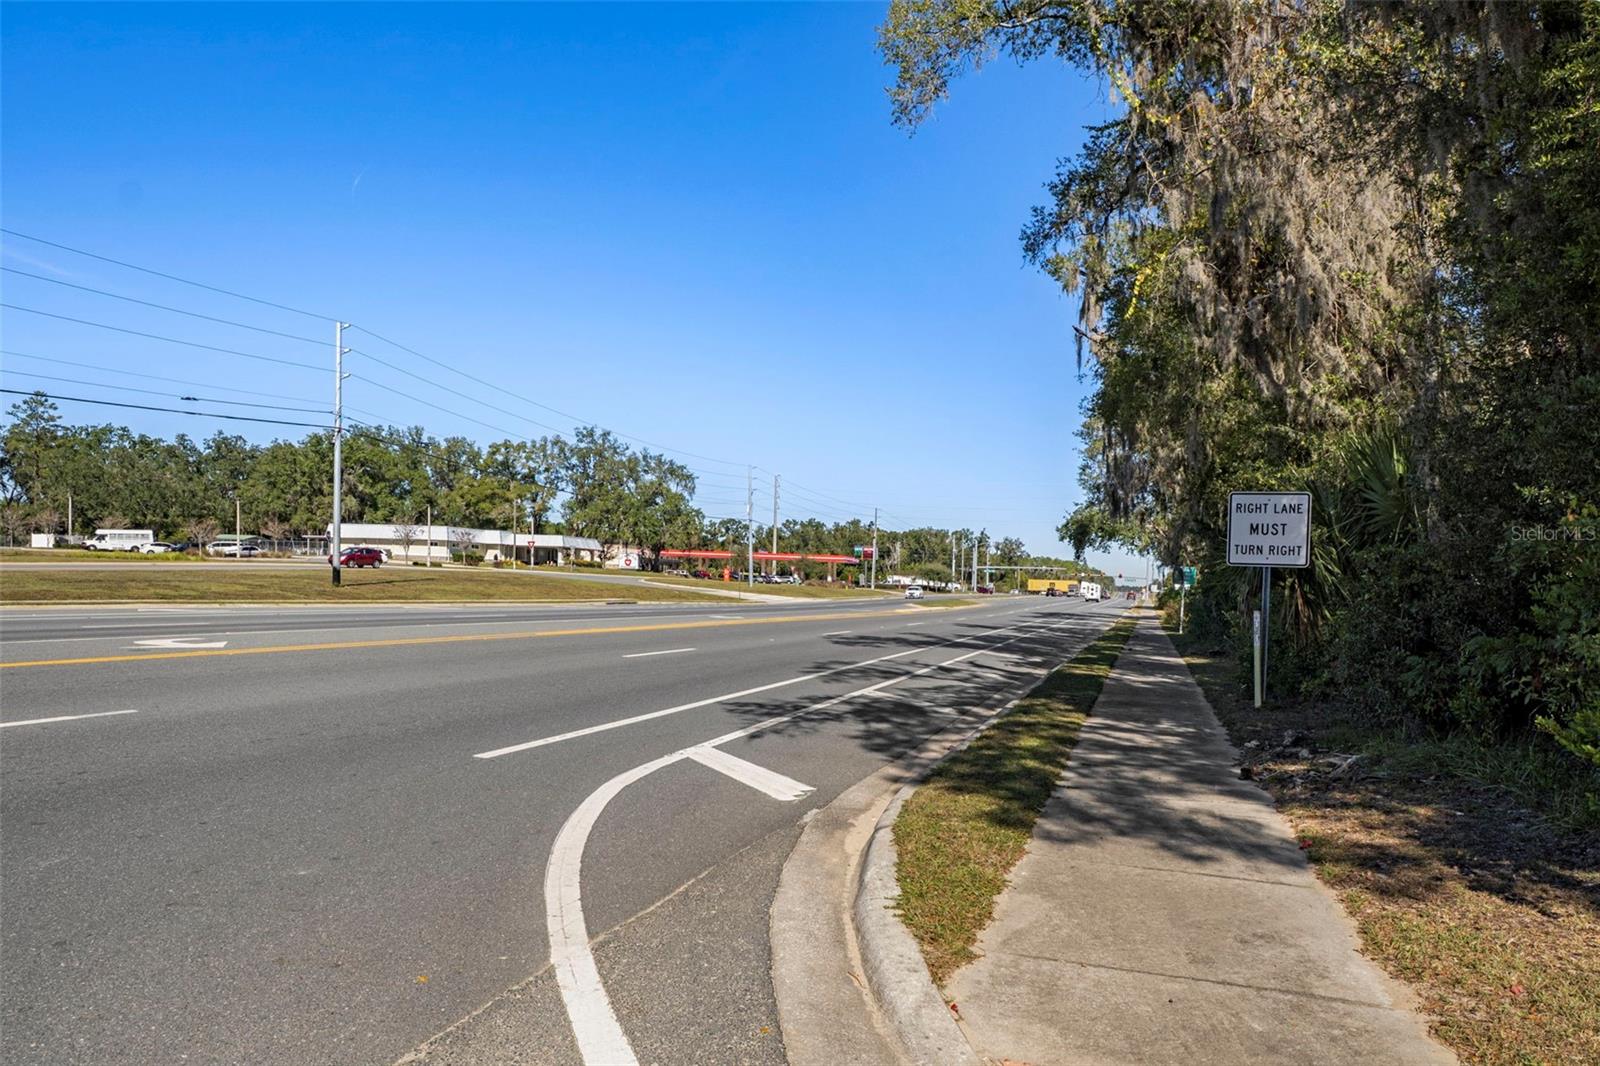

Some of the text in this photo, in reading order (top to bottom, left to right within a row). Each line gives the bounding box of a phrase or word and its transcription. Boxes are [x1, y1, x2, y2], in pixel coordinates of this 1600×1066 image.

[1236, 503, 1304, 514] RIGHT LANE
[1249, 523, 1288, 536] MUST
[1234, 544, 1302, 556] TURN RIGHT
